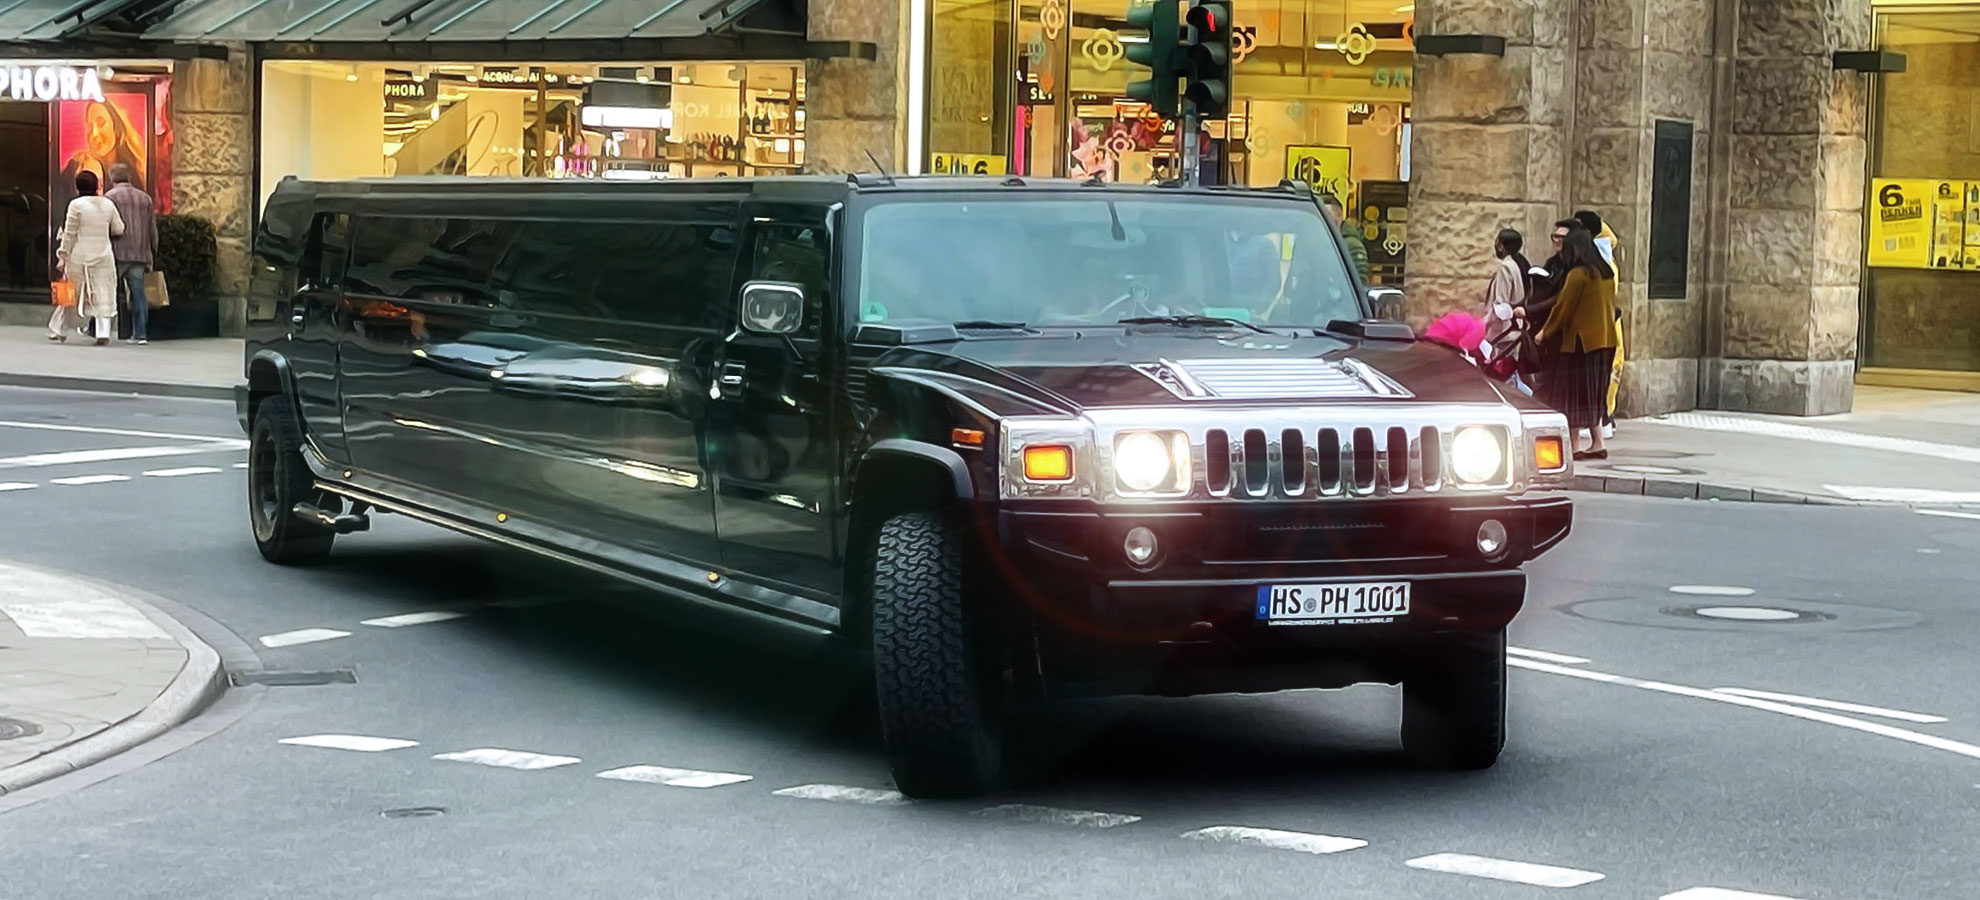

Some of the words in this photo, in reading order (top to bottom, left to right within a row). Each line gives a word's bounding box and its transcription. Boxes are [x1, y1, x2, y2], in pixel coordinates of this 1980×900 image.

[1879, 184, 1904, 207] 6
[1938, 183, 1950, 195] 6
[1272, 588, 1302, 615] HS
[1321, 587, 1350, 614] PH
[1353, 585, 1407, 613] 1001
